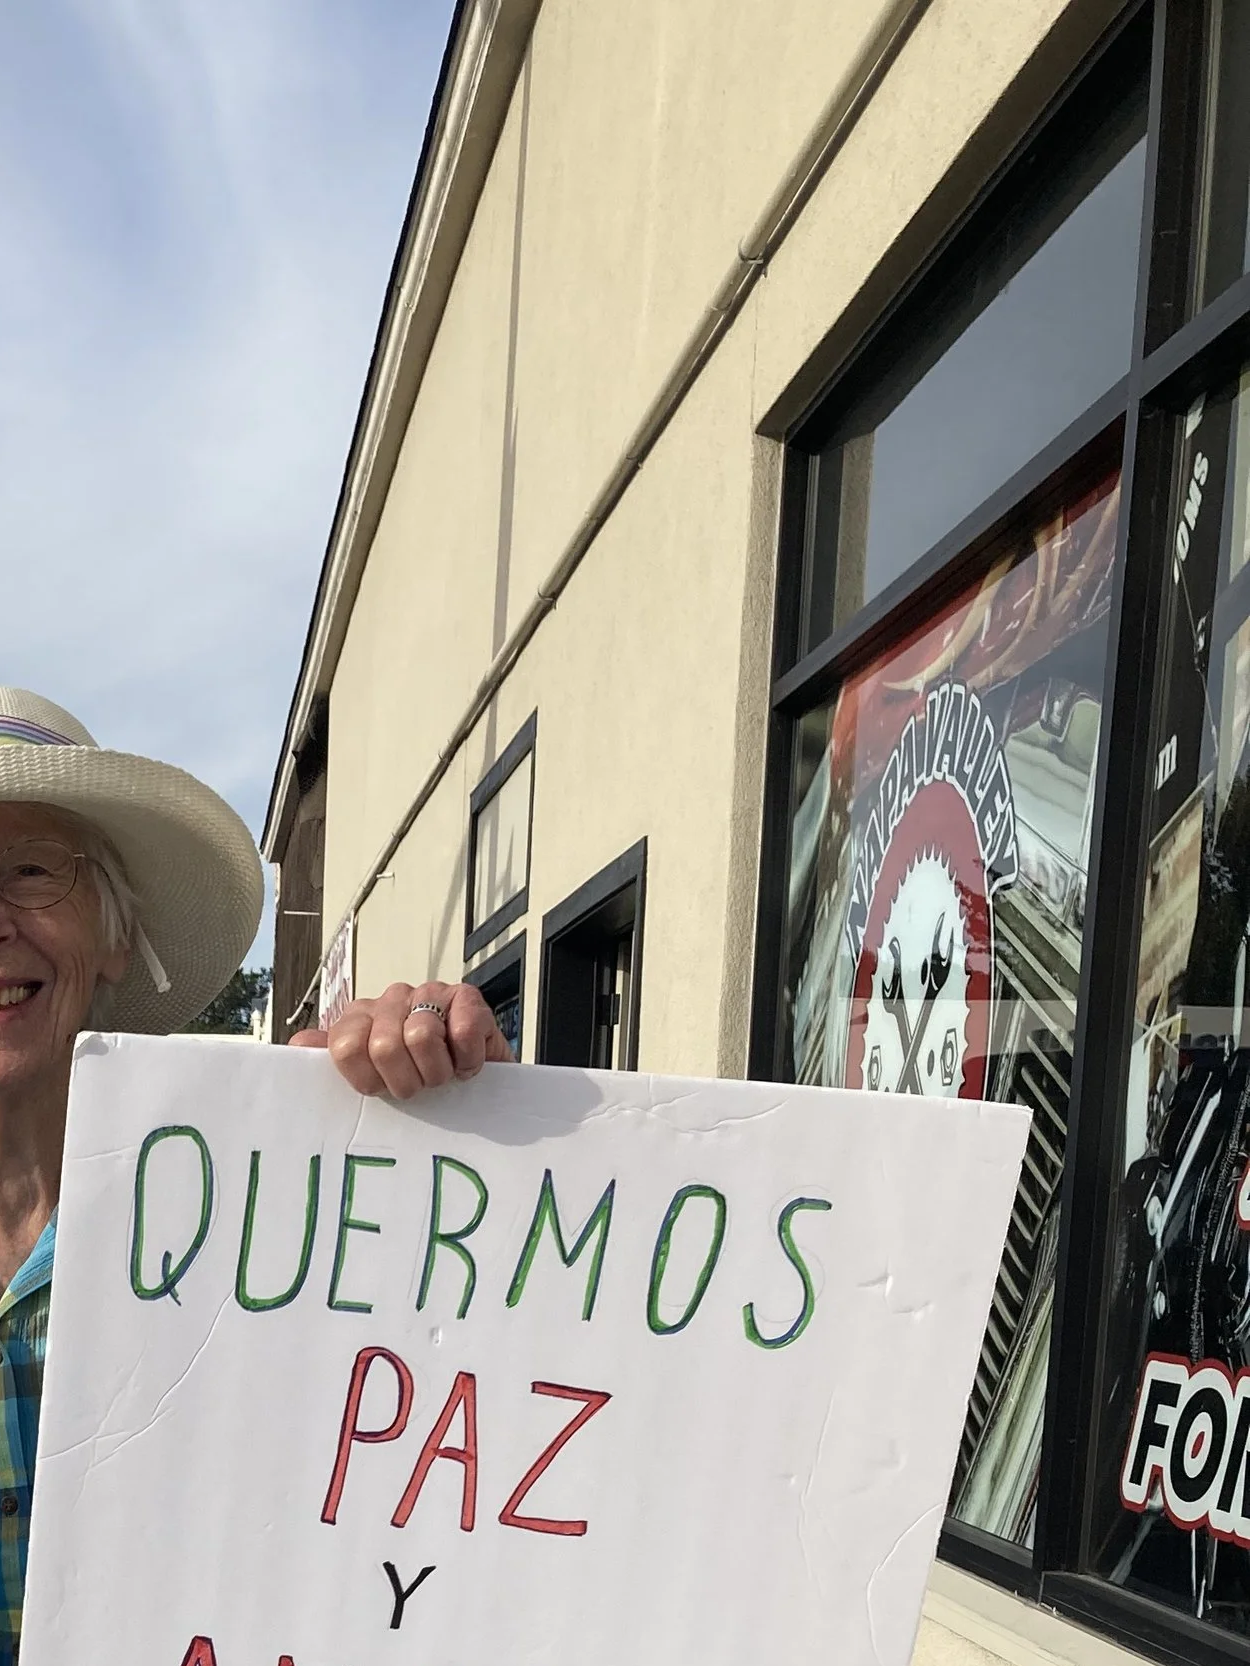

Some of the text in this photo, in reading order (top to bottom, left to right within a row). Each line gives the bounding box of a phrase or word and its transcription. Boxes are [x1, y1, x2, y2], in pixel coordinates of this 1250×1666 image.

[1172, 451, 1209, 586] OMS
[845, 682, 1019, 972] NAPA VALLEY
[130, 1126, 832, 1348] QUERMOS
[321, 1347, 612, 1536] PAZ
[383, 1561, 436, 1629] Y
